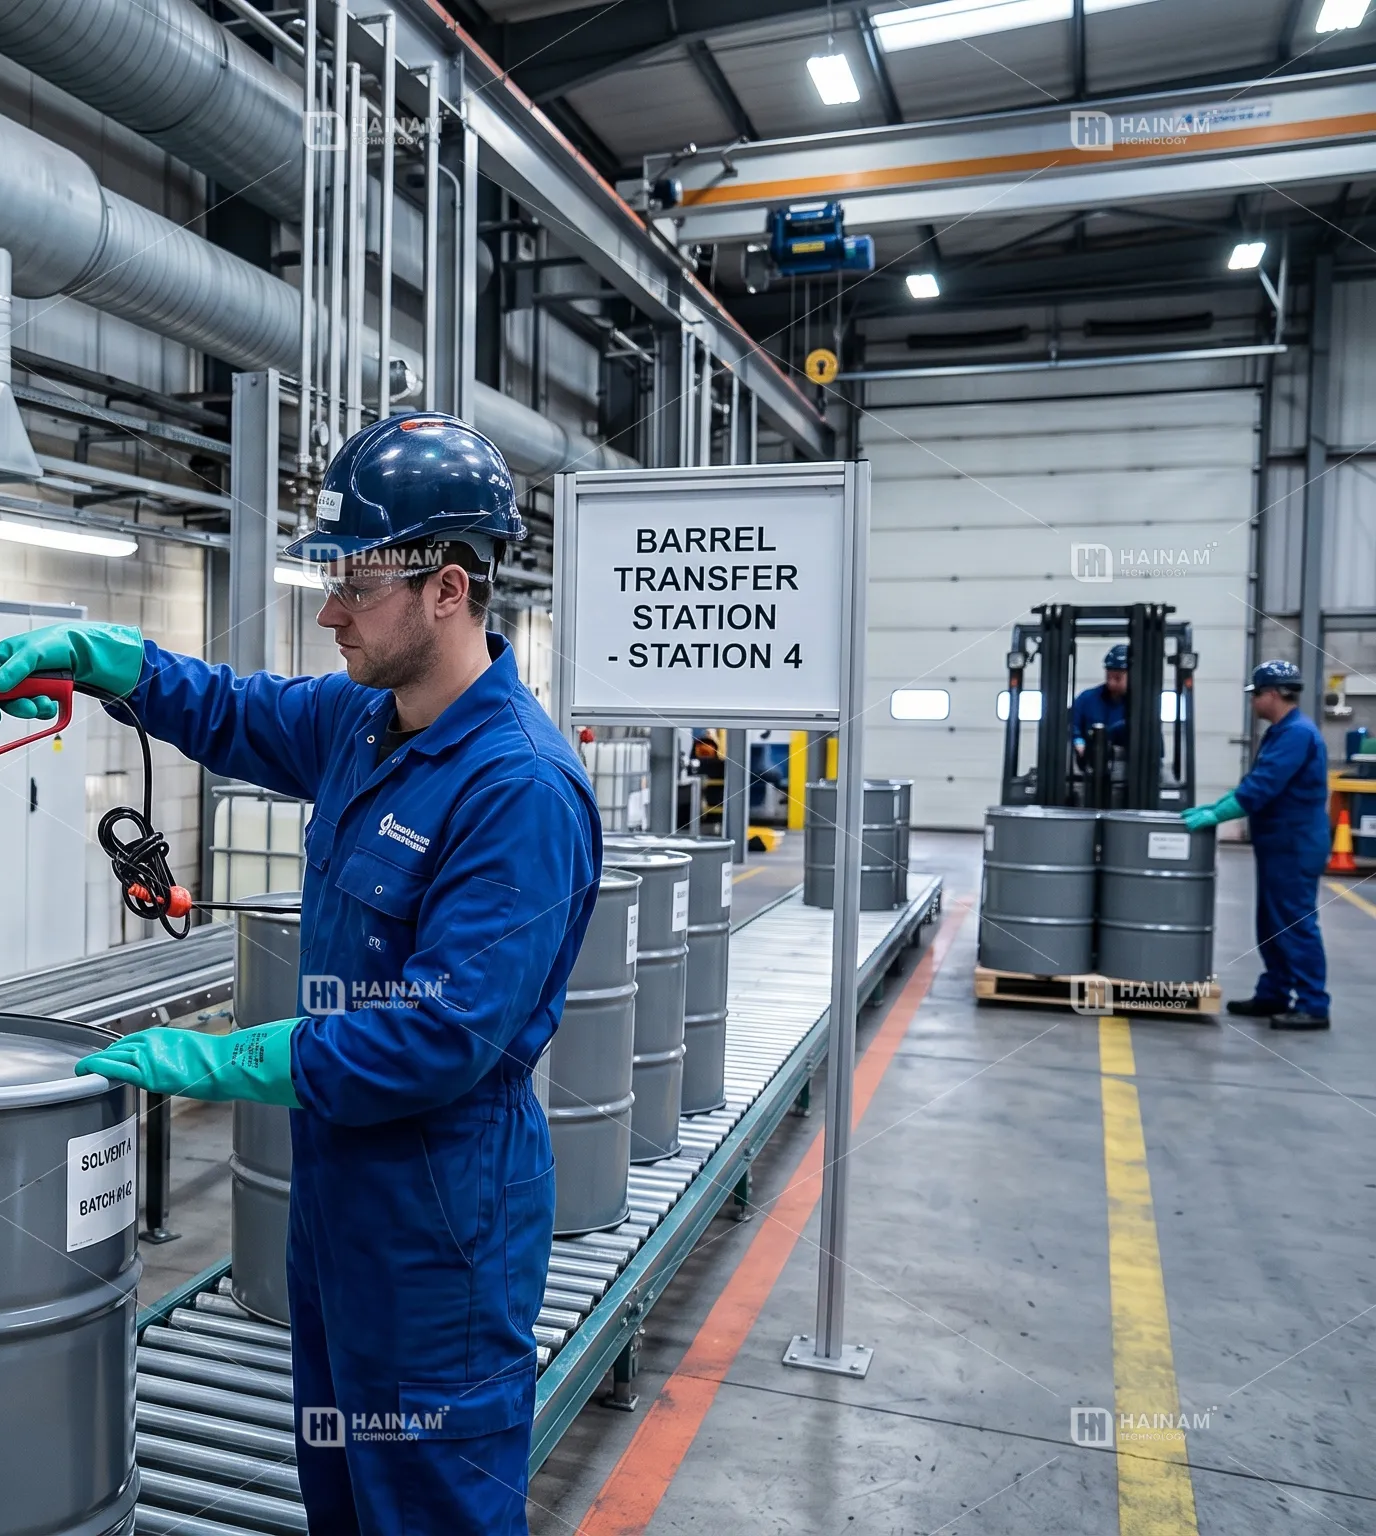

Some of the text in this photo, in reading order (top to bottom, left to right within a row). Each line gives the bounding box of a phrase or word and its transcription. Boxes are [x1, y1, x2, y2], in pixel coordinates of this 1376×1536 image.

[636, 526, 777, 554] BARREL
[613, 564, 799, 592] TRANSFER
[632, 603, 776, 630] STATION
[628, 642, 771, 669] STATION
[783, 643, 803, 669] 4
[79, 1189, 115, 1216] BATCH
